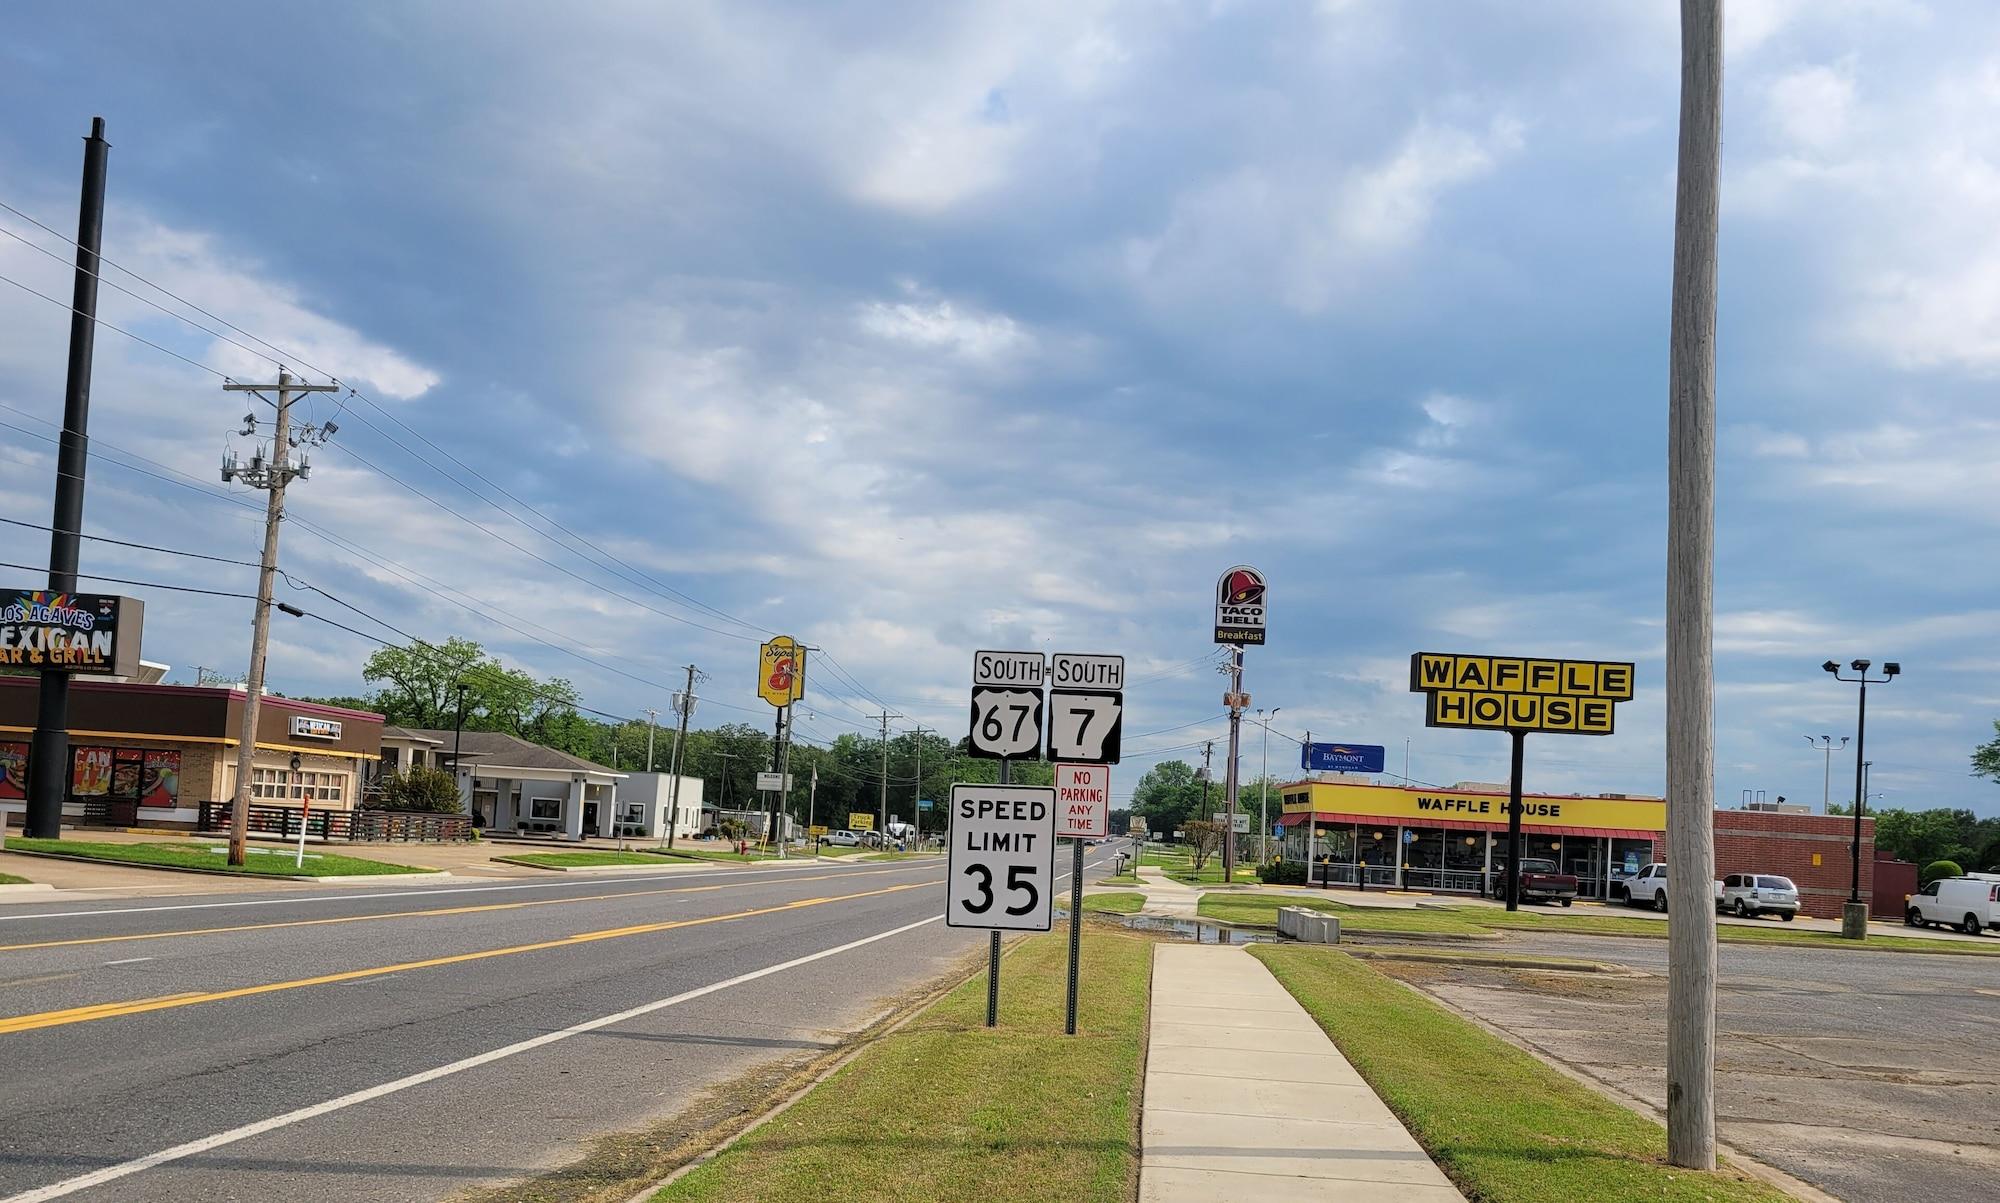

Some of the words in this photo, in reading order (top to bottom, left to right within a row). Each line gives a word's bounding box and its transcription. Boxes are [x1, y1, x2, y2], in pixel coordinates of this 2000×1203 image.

[29, 605, 95, 630] AGAVES
[1220, 607, 1263, 615] TACO
[1222, 616, 1263, 624] BELL
[0, 626, 112, 656] EXICAN
[1217, 631, 1263, 640] Breakfast
[30, 647, 43, 663] &
[979, 656, 1041, 681] SOUTH
[1057, 659, 1119, 684] SOUTH
[1424, 660, 1626, 692] WAFFLE
[1440, 696, 1607, 727] HOUSE
[982, 704, 1030, 742] 67
[1069, 708, 1096, 746] 7
[1323, 752, 1364, 762] BAYMONT
[1073, 771, 1091, 785] NO
[1060, 788, 1103, 803] PARKING
[1417, 797, 1490, 813] WAFFLE
[960, 799, 1046, 821] SPEED
[1068, 805, 1093, 815] ANY
[1067, 818, 1092, 830] TIME
[967, 831, 1037, 853] LIMIT
[961, 863, 1039, 916] 35
